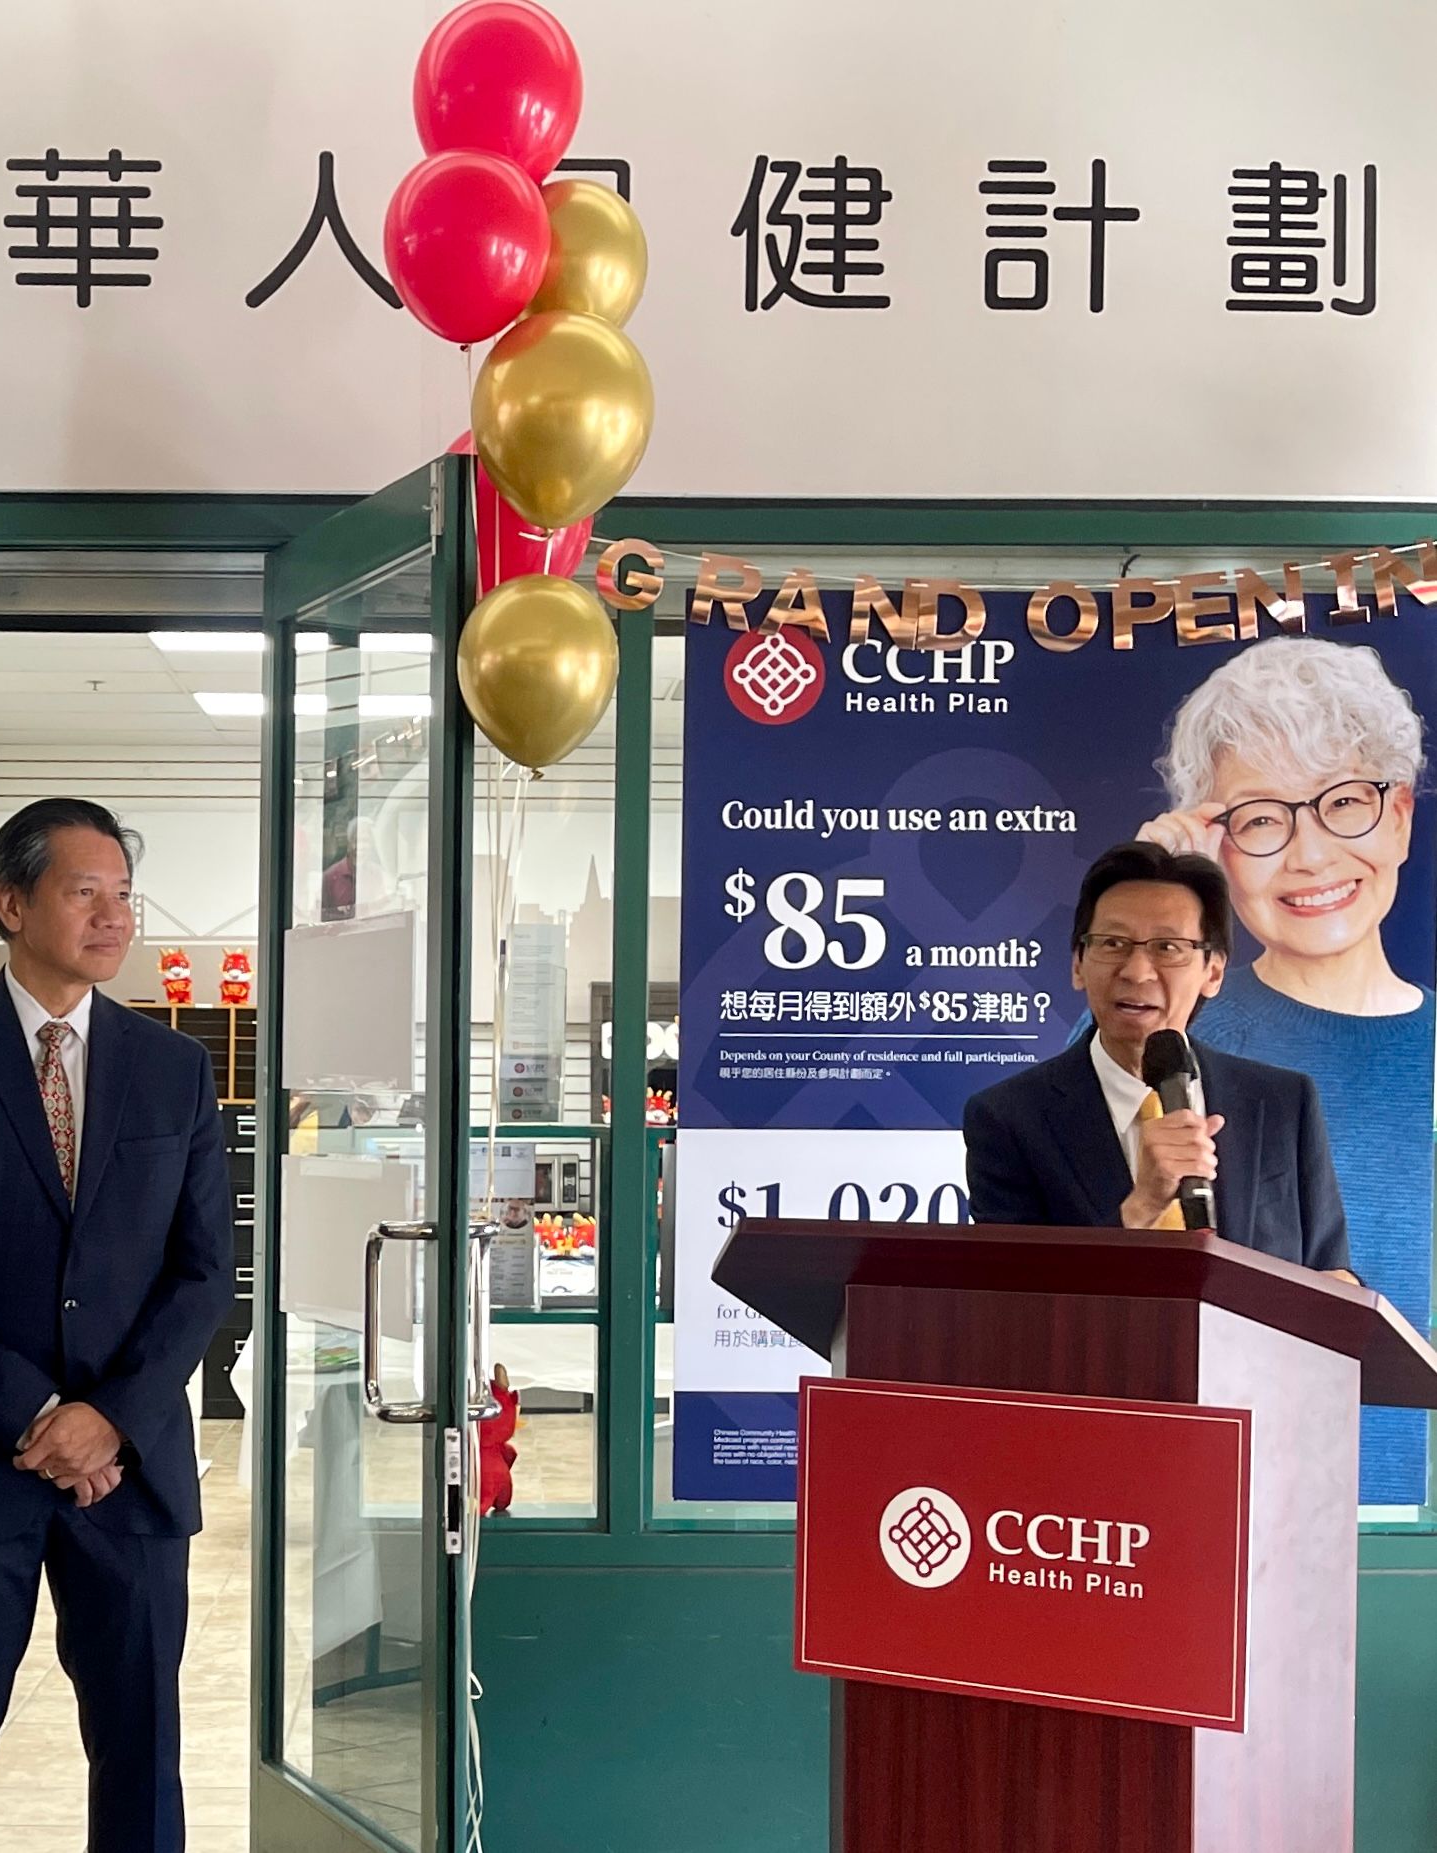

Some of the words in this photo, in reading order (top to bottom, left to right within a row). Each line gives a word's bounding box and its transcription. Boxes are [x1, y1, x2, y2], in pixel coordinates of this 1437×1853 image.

[595, 537, 987, 651] GRAND
[841, 638, 1015, 684] CCHP
[846, 693, 935, 713] Health
[949, 694, 1009, 713] Plan
[721, 800, 814, 831] Could
[821, 807, 882, 839] you
[886, 808, 943, 832] use
[949, 808, 988, 832] an
[994, 806, 1077, 834] extra
[724, 868, 886, 971] $85
[906, 947, 922, 968] a
[929, 940, 1042, 969] month?
[720, 1050, 766, 1063] Depends
[769, 1053, 783, 1061] on
[785, 1053, 811, 1063] your
[812, 1051, 850, 1064] County
[853, 1051, 866, 1061] of
[867, 1051, 919, 1062] residence
[921, 1052, 942, 1062] and
[944, 1051, 963, 1062] full
[965, 1052, 1039, 1065] participation.
[717, 1304, 741, 1320] for
[986, 1510, 1150, 1567] CCHP
[988, 1562, 1073, 1591] Health
[1086, 1573, 1143, 1598] Plan
